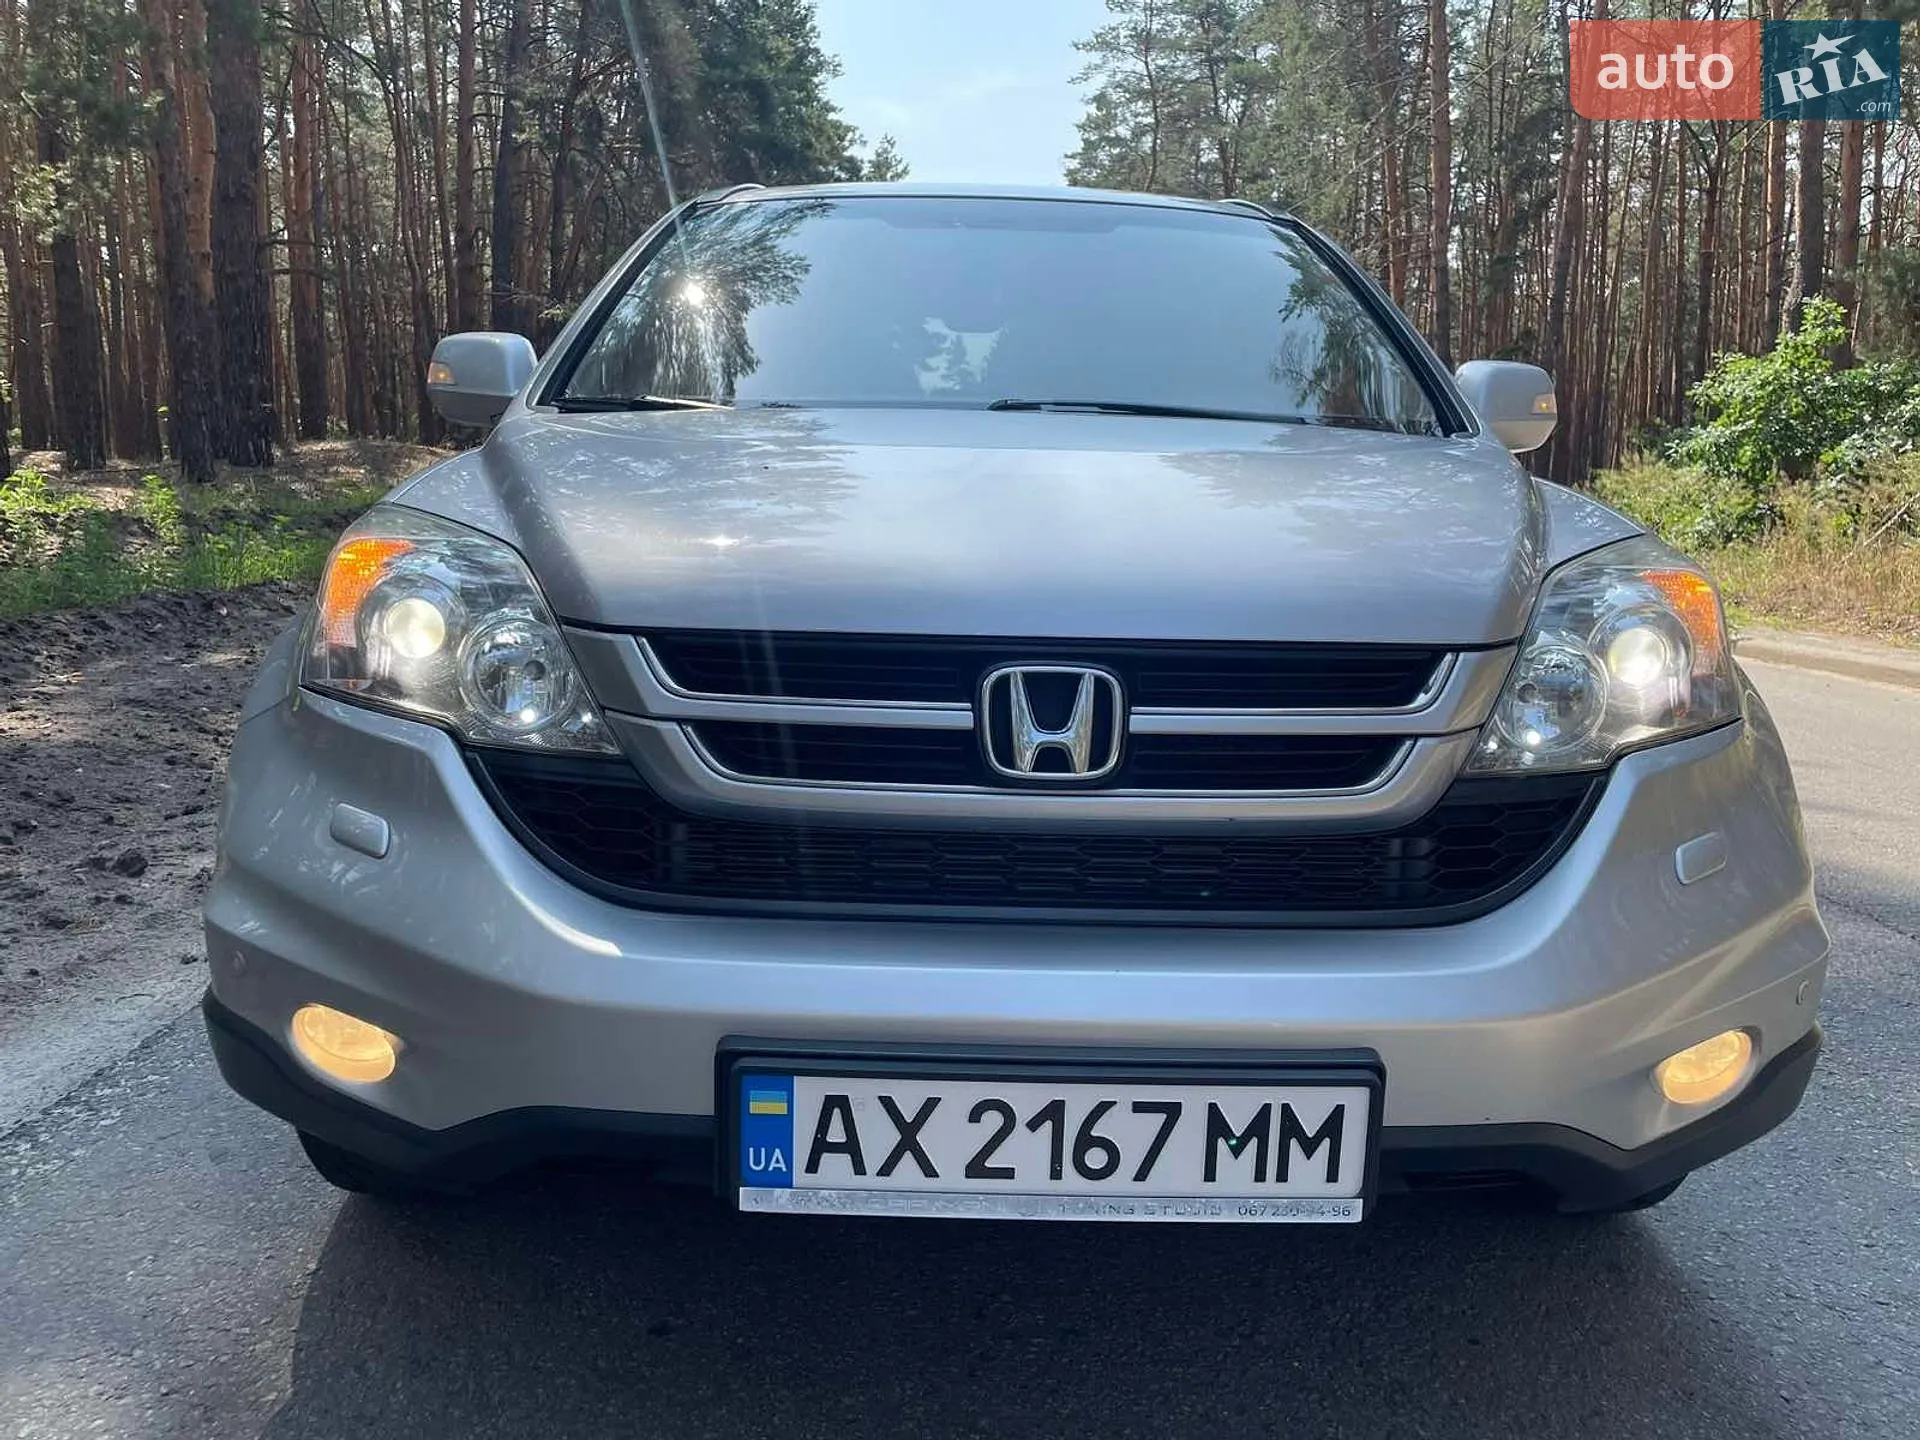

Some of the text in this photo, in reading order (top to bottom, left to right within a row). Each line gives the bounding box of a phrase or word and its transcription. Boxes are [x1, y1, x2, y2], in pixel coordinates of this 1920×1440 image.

[749, 1149, 787, 1173] UA
[804, 1095, 1346, 1183] AX 2167 MM
